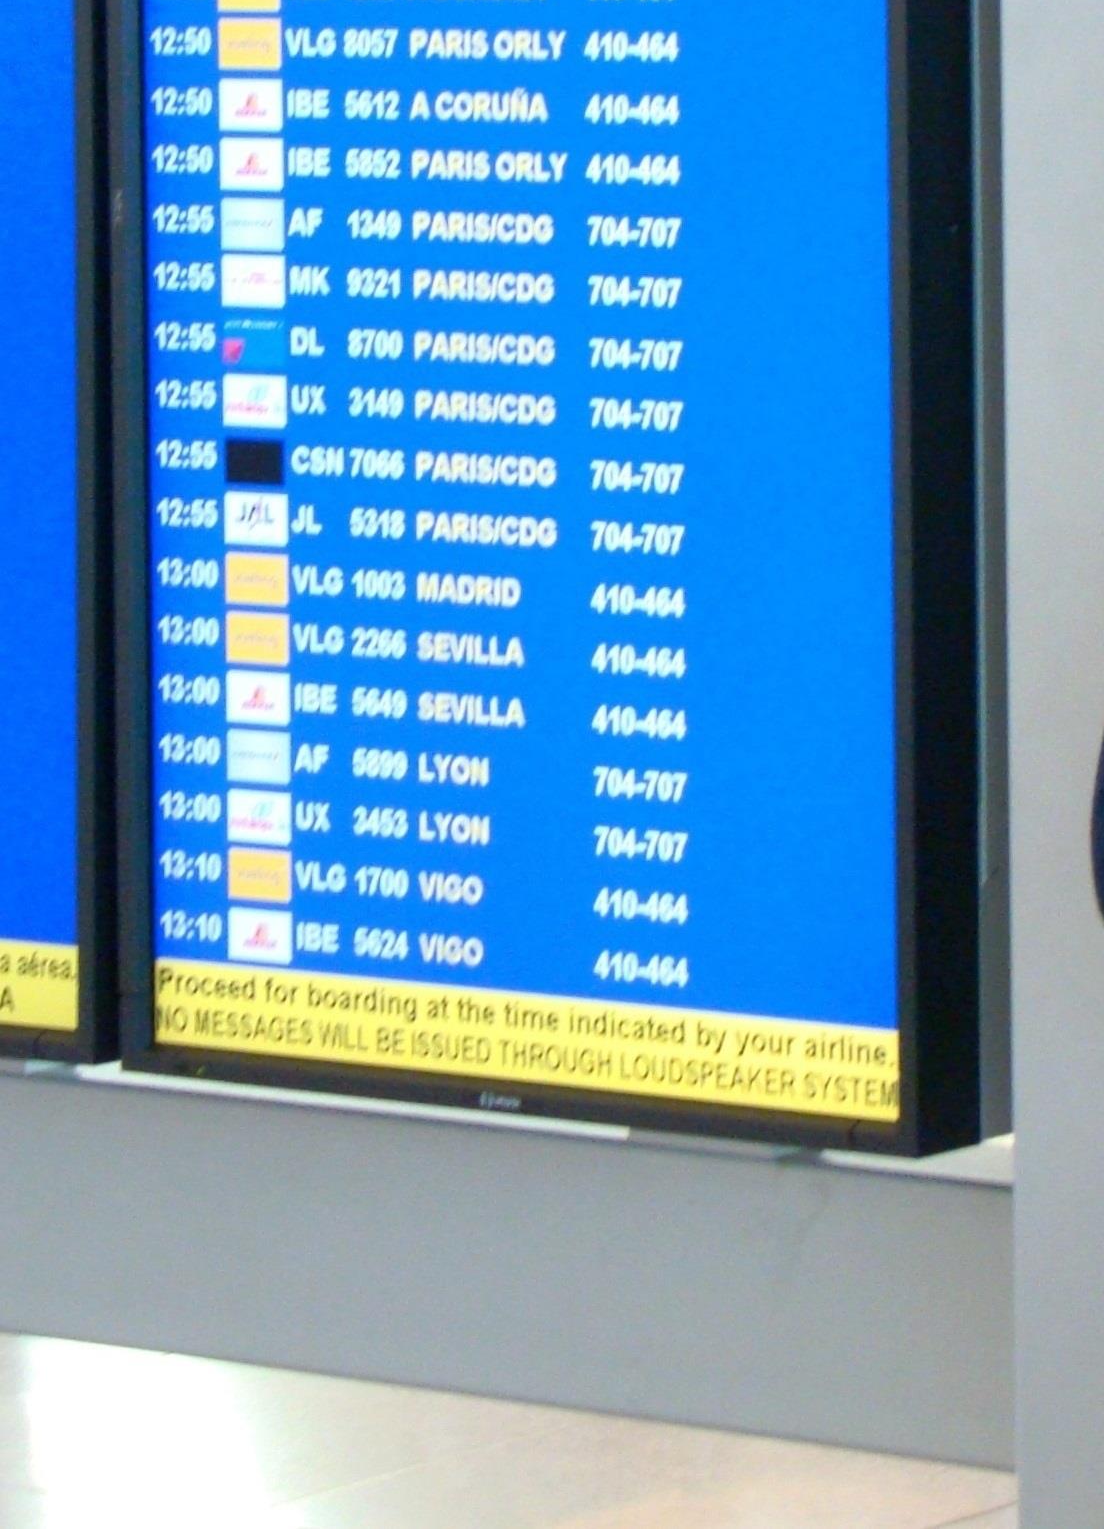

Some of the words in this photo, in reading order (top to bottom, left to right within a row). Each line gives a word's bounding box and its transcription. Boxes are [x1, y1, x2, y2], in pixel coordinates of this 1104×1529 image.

[151, 27, 210, 54] 12:50
[284, 28, 336, 56] VLG
[344, 29, 398, 57] 8057
[410, 29, 489, 60] PARIS
[492, 29, 565, 60] ORLY
[584, 32, 679, 61] 410-464
[152, 87, 210, 114] 12:50
[287, 89, 329, 118] IBE
[345, 90, 399, 119] 5612
[410, 93, 430, 121] A
[433, 88, 548, 121] CORUÑA
[585, 94, 679, 124] 410-464
[153, 145, 211, 172] 12:50
[288, 147, 330, 176] IBE
[411, 150, 491, 182] PARIS
[494, 150, 566, 182] ORLY
[586, 154, 680, 184] 410-464
[154, 205, 212, 233] 12:55
[288, 208, 322, 236] AF
[412, 211, 554, 244] PARIS/CDG
[588, 216, 681, 247] 704-707
[154, 262, 213, 290] 12:55
[289, 266, 329, 294] MK
[413, 269, 554, 303] PARIS/CDG
[589, 275, 682, 307] 704-707
[155, 323, 214, 350] 12:55
[291, 327, 324, 355] DL
[414, 331, 555, 365] PARIS/CDG
[590, 338, 682, 370] 704-707
[156, 380, 214, 409] 12:55
[291, 385, 325, 413] UX
[415, 390, 556, 425] PARIS/CDG
[590, 398, 683, 430] 704-707
[157, 440, 215, 468] 12:55
[291, 446, 344, 475] CSN
[415, 451, 556, 487] PARIS/CDG
[591, 460, 684, 493] 704-707
[157, 498, 216, 527] 12:55
[291, 505, 321, 534] JL
[416, 511, 557, 547] PARIS/CDG
[591, 521, 684, 554] 704-707
[158, 558, 217, 587] 13:00
[292, 566, 343, 595] VLG
[352, 570, 405, 599] 1003
[417, 573, 521, 607] MADRID
[591, 584, 685, 617] 410-464
[159, 616, 218, 645] 13:00
[292, 624, 344, 654] VLG
[417, 632, 524, 666] SEVILLA
[592, 644, 686, 677] 410-464
[159, 674, 218, 704] 13:00
[294, 683, 337, 713] IBE
[418, 692, 525, 727] SEVILLA
[592, 705, 686, 739] 410-464
[160, 734, 219, 764] 13:00
[294, 744, 329, 773] AF
[419, 753, 489, 786] LYON
[594, 766, 687, 802] 704-707
[160, 791, 220, 822] 13:00
[296, 802, 330, 831] UX
[419, 812, 490, 845] LYON
[595, 826, 688, 862] 704-707
[161, 851, 221, 880] 13:10
[295, 861, 346, 892] VLG
[355, 867, 409, 898] 1700
[419, 872, 483, 905] VIGO
[594, 888, 688, 924] 410-464
[161, 911, 222, 941] 13:10
[296, 922, 339, 953] IBE
[419, 934, 483, 966] VIGO
[594, 951, 688, 987] 410-464
[158, 967, 255, 1002] Proceed
[265, 977, 299, 1004] for
[307, 981, 417, 1021] boarding
[427, 995, 450, 1019] at
[457, 996, 494, 1023] the
[504, 1002, 559, 1031] time
[569, 1007, 685, 1043] indicated
[697, 1020, 727, 1054] by
[737, 1032, 795, 1057] your
[804, 1032, 896, 1067] airline.
[155, 1006, 188, 1032] NO
[194, 1009, 313, 1045] MESSAGES
[319, 1020, 368, 1051] WILL
[376, 1026, 405, 1055] BE
[410, 1030, 491, 1063] ISSUED
[499, 1038, 612, 1077] THROUGH
[620, 1051, 795, 1095] LOUDSPEAKER
[803, 1071, 899, 1107] SYSTEM
